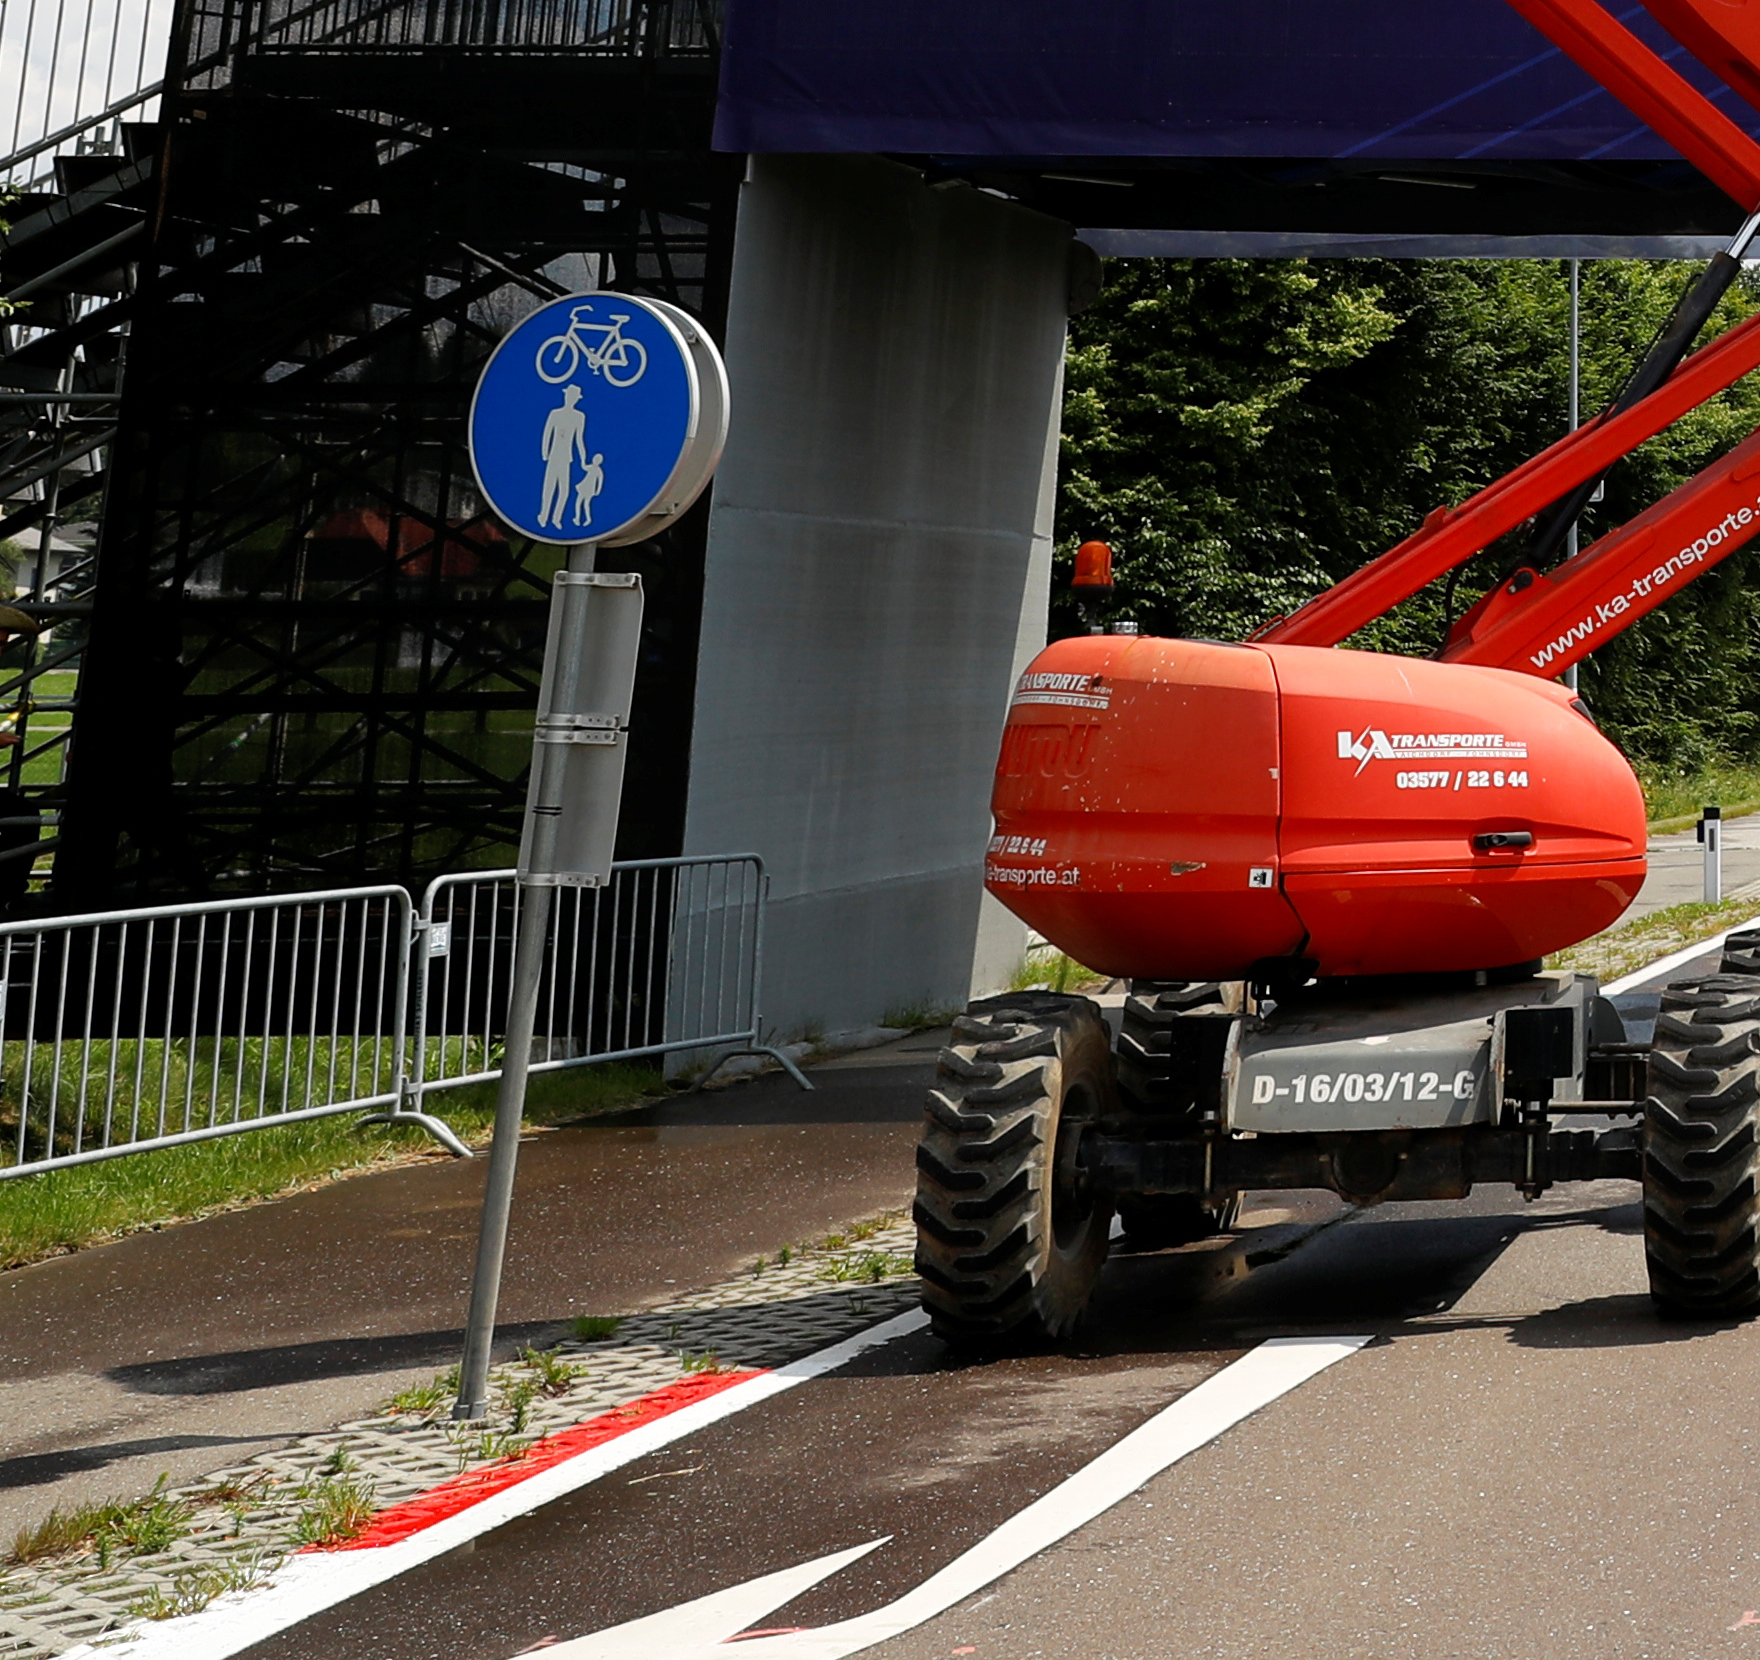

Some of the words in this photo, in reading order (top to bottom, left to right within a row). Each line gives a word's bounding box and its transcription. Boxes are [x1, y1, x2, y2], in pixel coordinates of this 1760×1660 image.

[1337, 725, 1396, 774] KA
[1391, 734, 1505, 748] TRANSPORTE
[1396, 771, 1450, 789] 03577
[1467, 771, 1490, 788] 22
[1493, 771, 1505, 788] 6
[1507, 771, 1529, 788] 44
[987, 865, 1080, 886] -transporte.at
[1252, 1071, 1475, 1104] D-16/03/12-G
